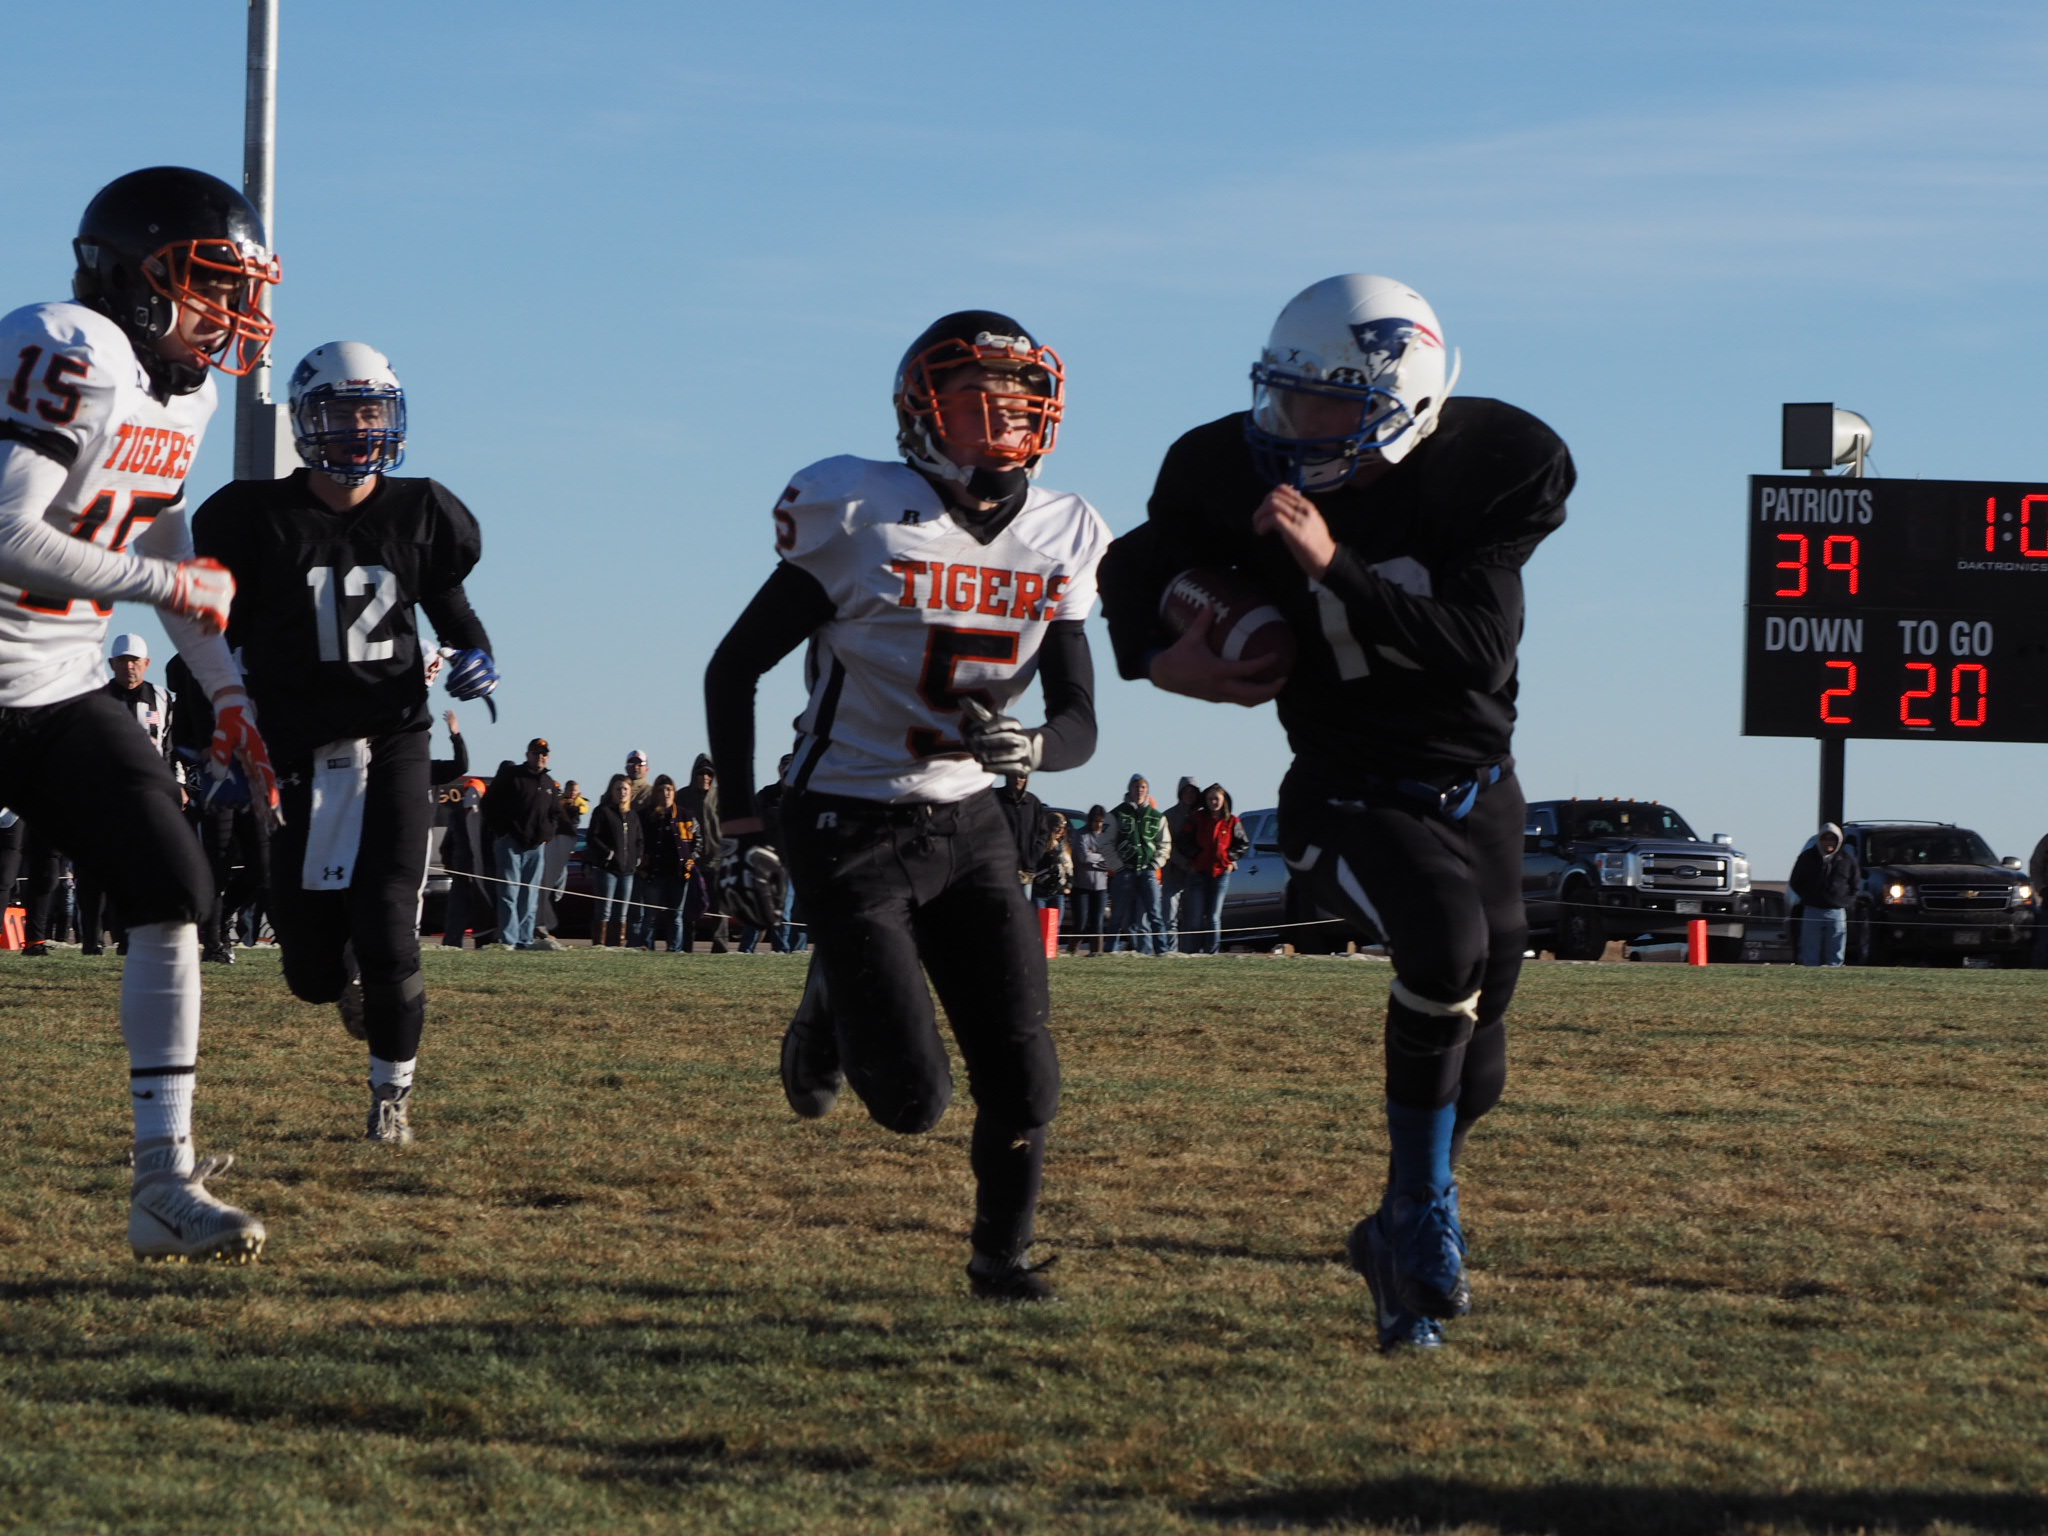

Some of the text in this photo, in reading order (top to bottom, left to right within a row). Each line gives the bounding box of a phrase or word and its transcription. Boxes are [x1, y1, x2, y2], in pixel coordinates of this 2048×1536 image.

[7, 344, 90, 426] 15
[103, 423, 195, 479] TIGERS
[1760, 486, 1874, 525] PATRIOTS
[892, 558, 1071, 622] TIGERS
[1775, 533, 1859, 597] 39
[1957, 560, 2048, 572] DAKTRONICS
[306, 563, 402, 664] 12
[1764, 616, 1864, 653] DOWN
[1898, 619, 1994, 657] TO GO
[906, 625, 1020, 760] 5
[1820, 660, 1857, 724] 2
[1900, 661, 1989, 728] 20
